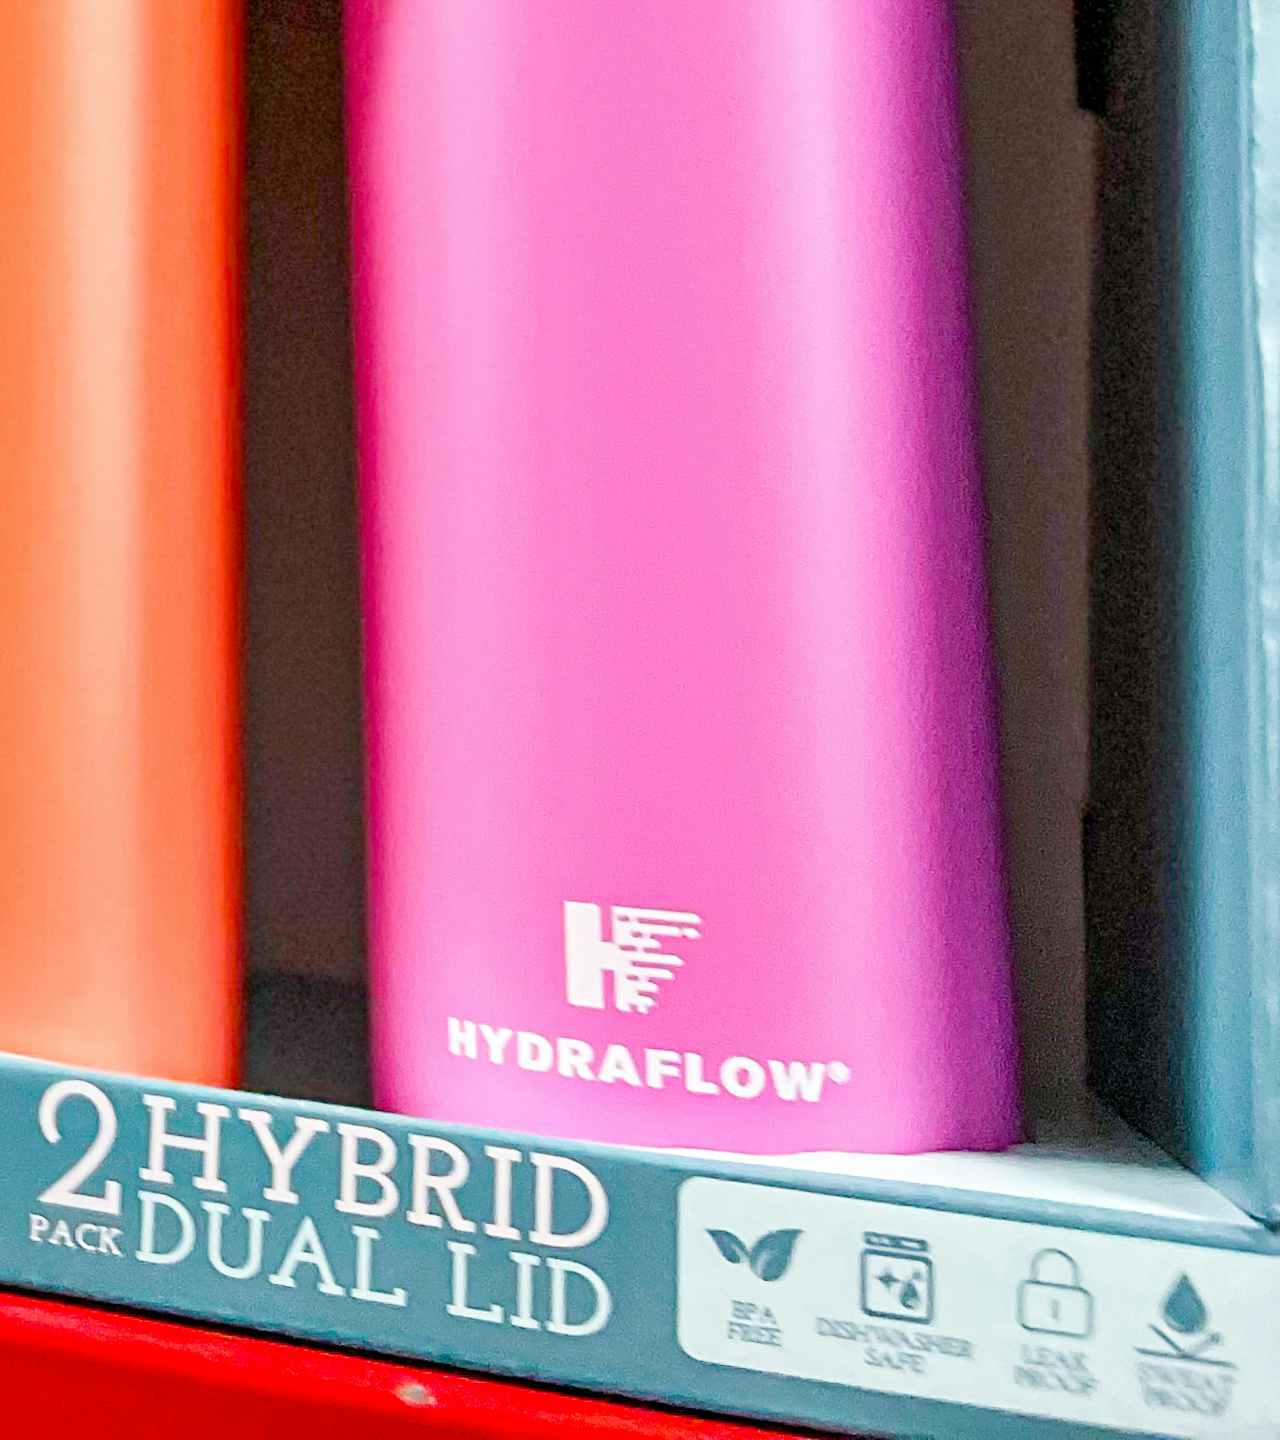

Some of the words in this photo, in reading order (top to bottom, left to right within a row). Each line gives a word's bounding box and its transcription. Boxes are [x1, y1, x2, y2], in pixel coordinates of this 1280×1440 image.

[28, 1212, 125, 1258] PACK
[38, 1078, 124, 1216] 2
[138, 1094, 611, 1249] HYBRID
[135, 1190, 408, 1308] DUAL
[446, 1239, 614, 1338] LID
